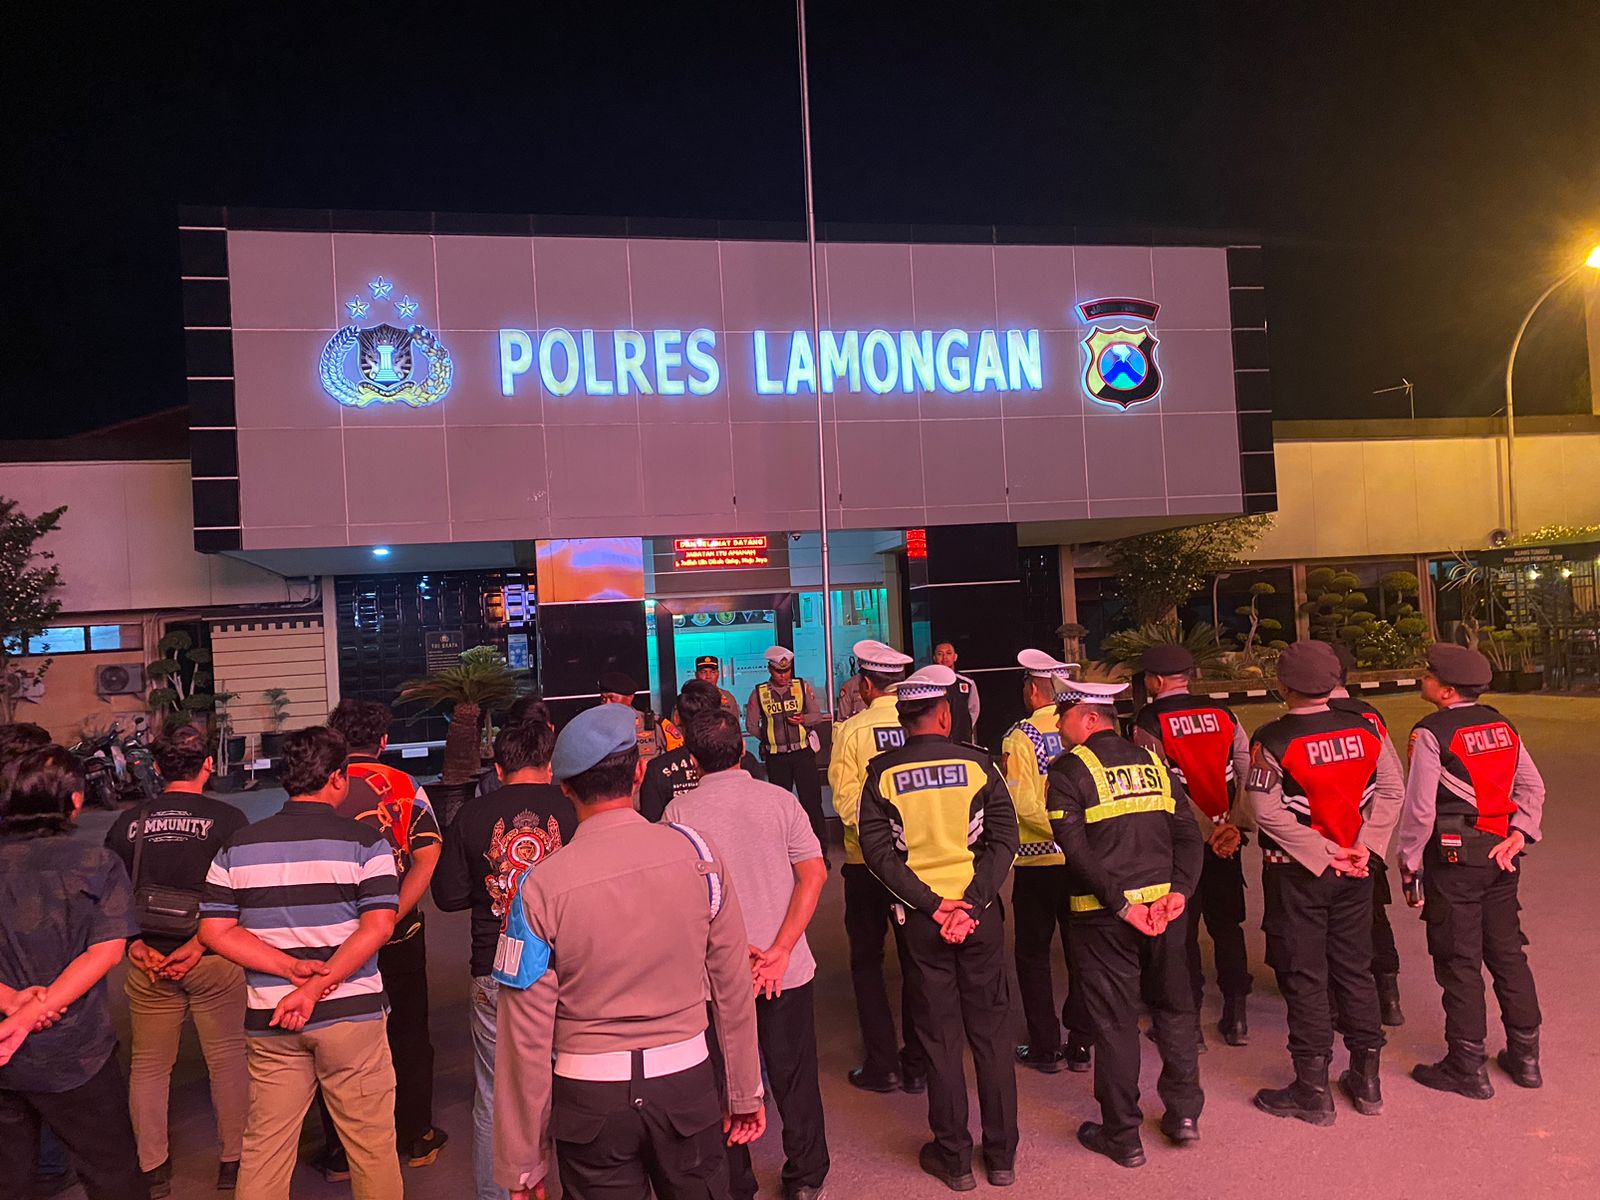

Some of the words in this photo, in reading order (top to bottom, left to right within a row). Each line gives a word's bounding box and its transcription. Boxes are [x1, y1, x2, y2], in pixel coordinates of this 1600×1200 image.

[498, 327, 720, 397] POLRES
[753, 329, 1043, 395] LAMONGAN
[686, 550, 715, 558] JABATAN
[733, 539, 764, 547] DATANG
[767, 700, 799, 713] POLISI
[1169, 713, 1220, 737] POLISI
[1306, 735, 1365, 766] POLISI
[1463, 728, 1512, 754] POLISI
[896, 765, 966, 791] POLISI
[1106, 767, 1163, 794] POLISI
[128, 818, 213, 841] CMMUNITY
